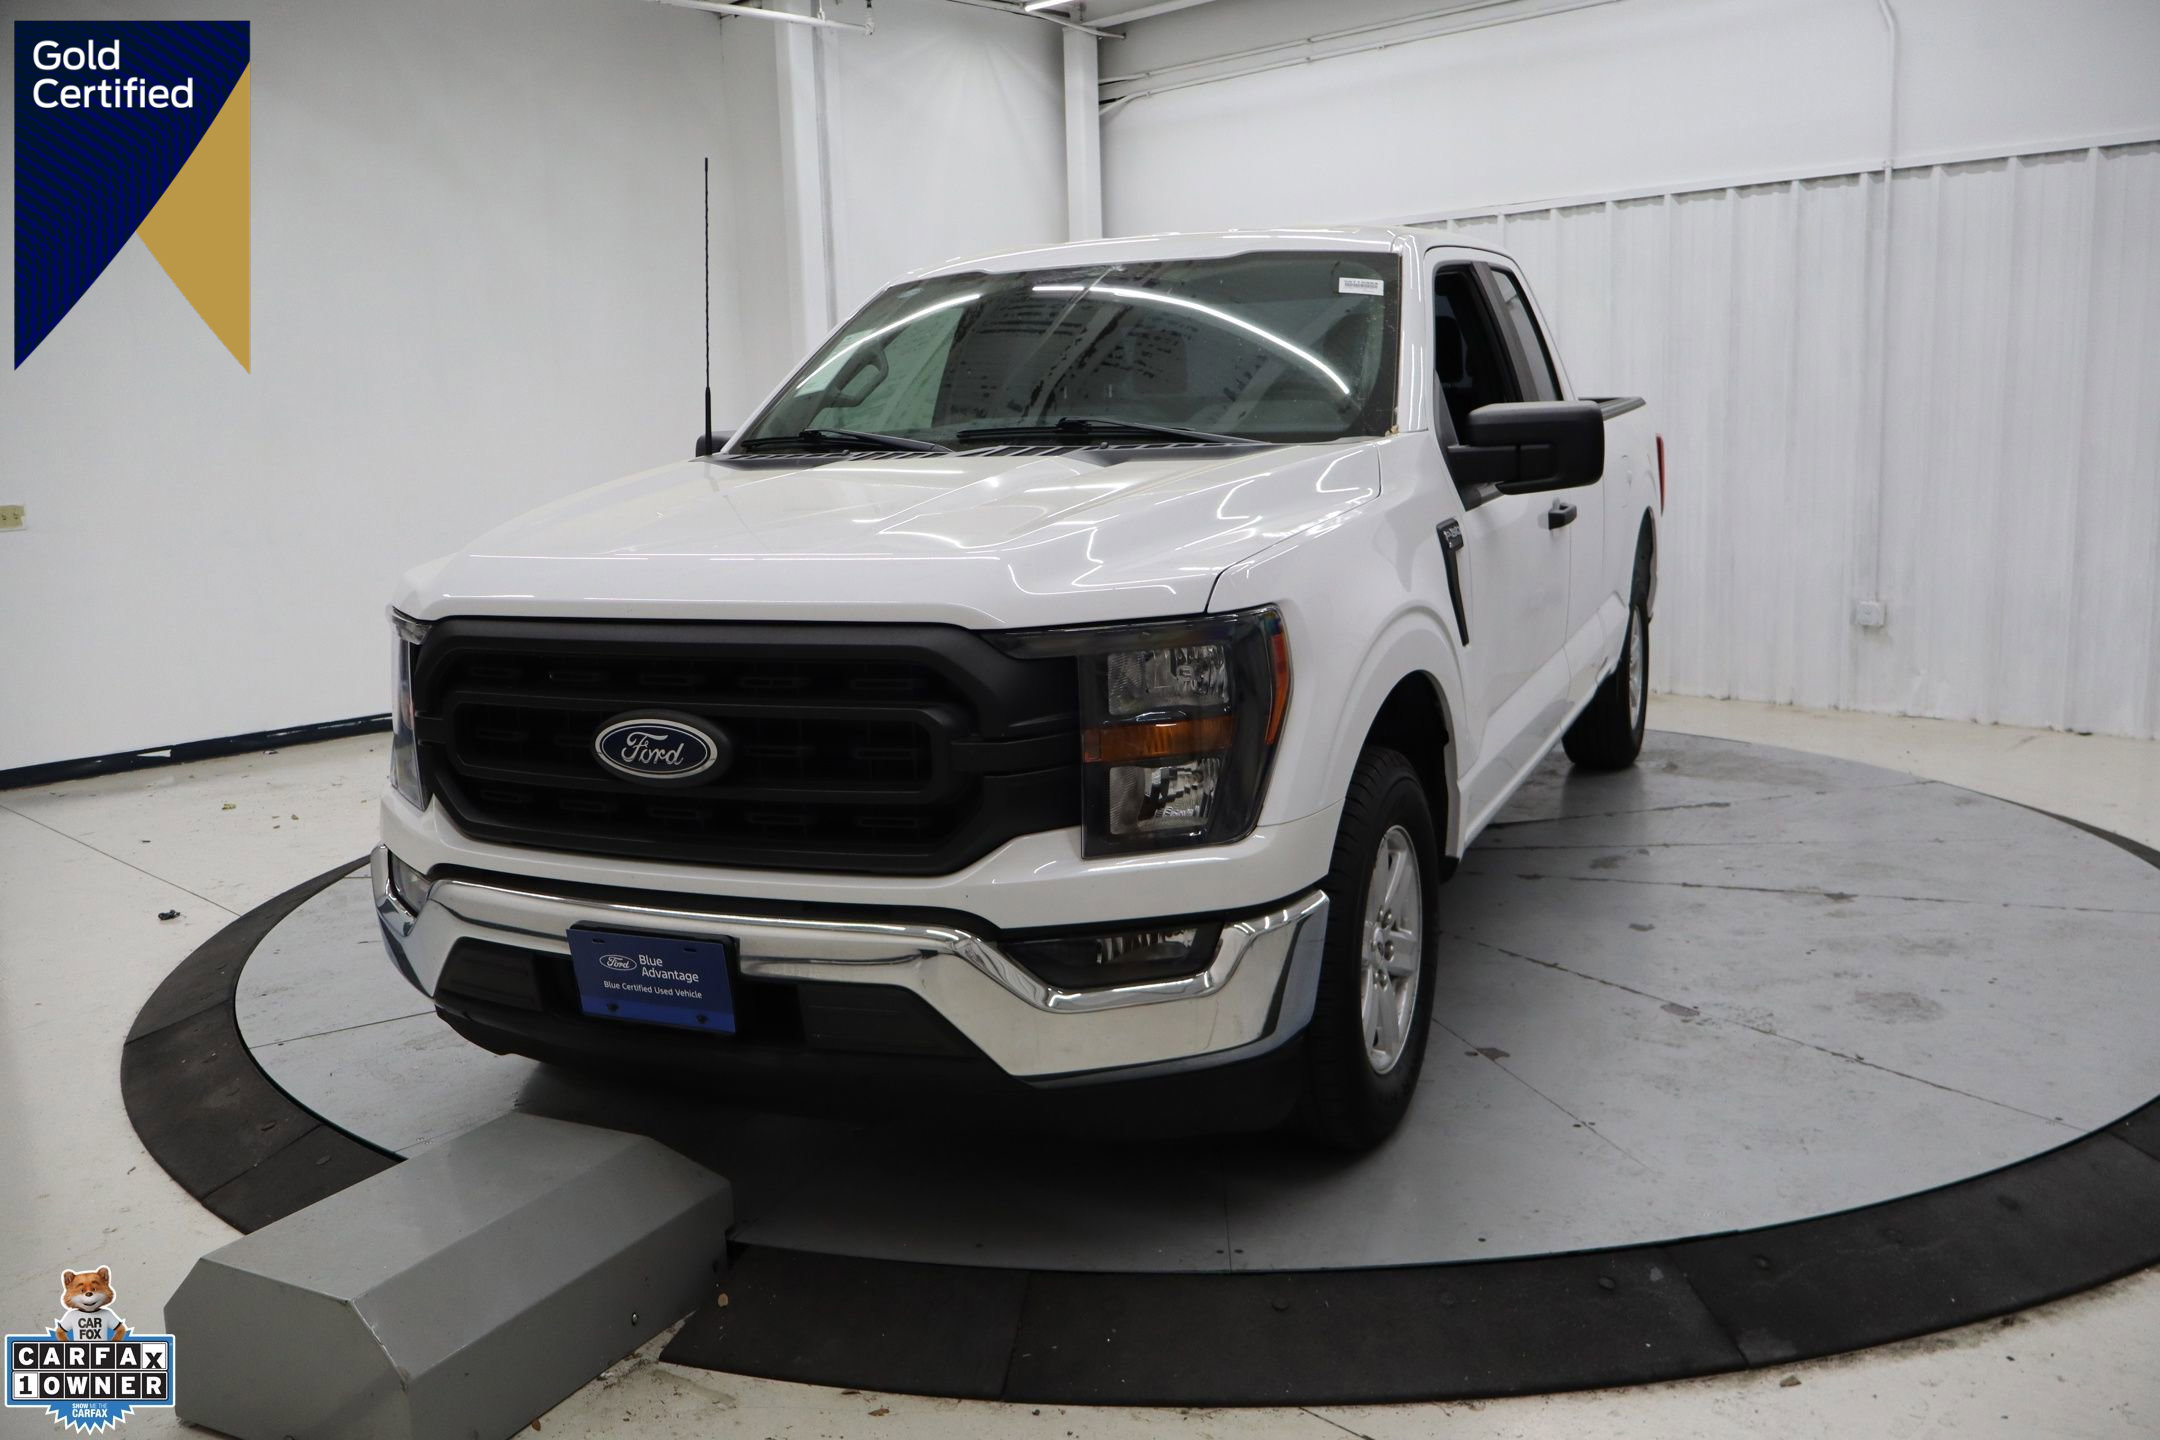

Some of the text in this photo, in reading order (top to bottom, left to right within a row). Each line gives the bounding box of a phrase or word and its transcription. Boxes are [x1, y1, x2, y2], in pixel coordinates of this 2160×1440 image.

[621, 731, 685, 766] Ford
[606, 956, 630, 970] Ford
[638, 954, 663, 967] Blue
[641, 966, 700, 983] Advantage
[603, 980, 703, 999] Blue Certified Used Vehicle
